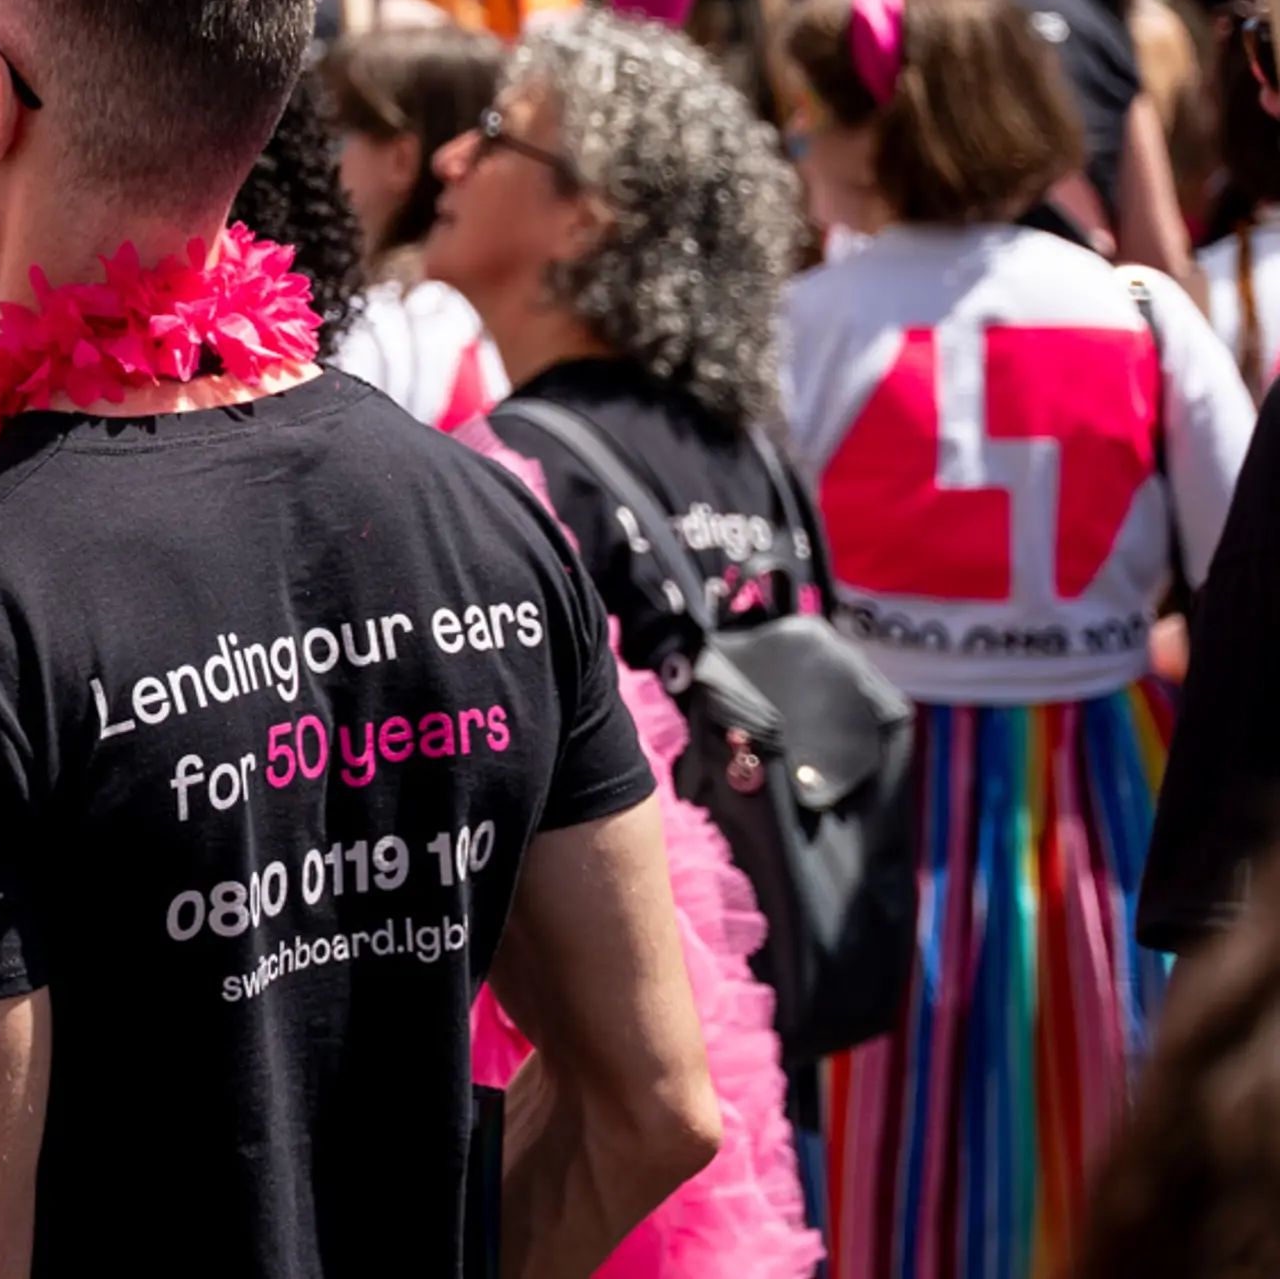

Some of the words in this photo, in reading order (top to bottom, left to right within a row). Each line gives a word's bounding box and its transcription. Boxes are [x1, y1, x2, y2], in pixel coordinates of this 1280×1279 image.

[90, 633, 298, 740] Lending
[303, 613, 413, 675] our
[432, 600, 544, 654] ears
[170, 753, 256, 821] for
[265, 714, 328, 789] 50
[339, 704, 511, 788] years
[166, 860, 288, 942] 0800
[302, 834, 409, 905] 0119
[427, 820, 495, 887] 100
